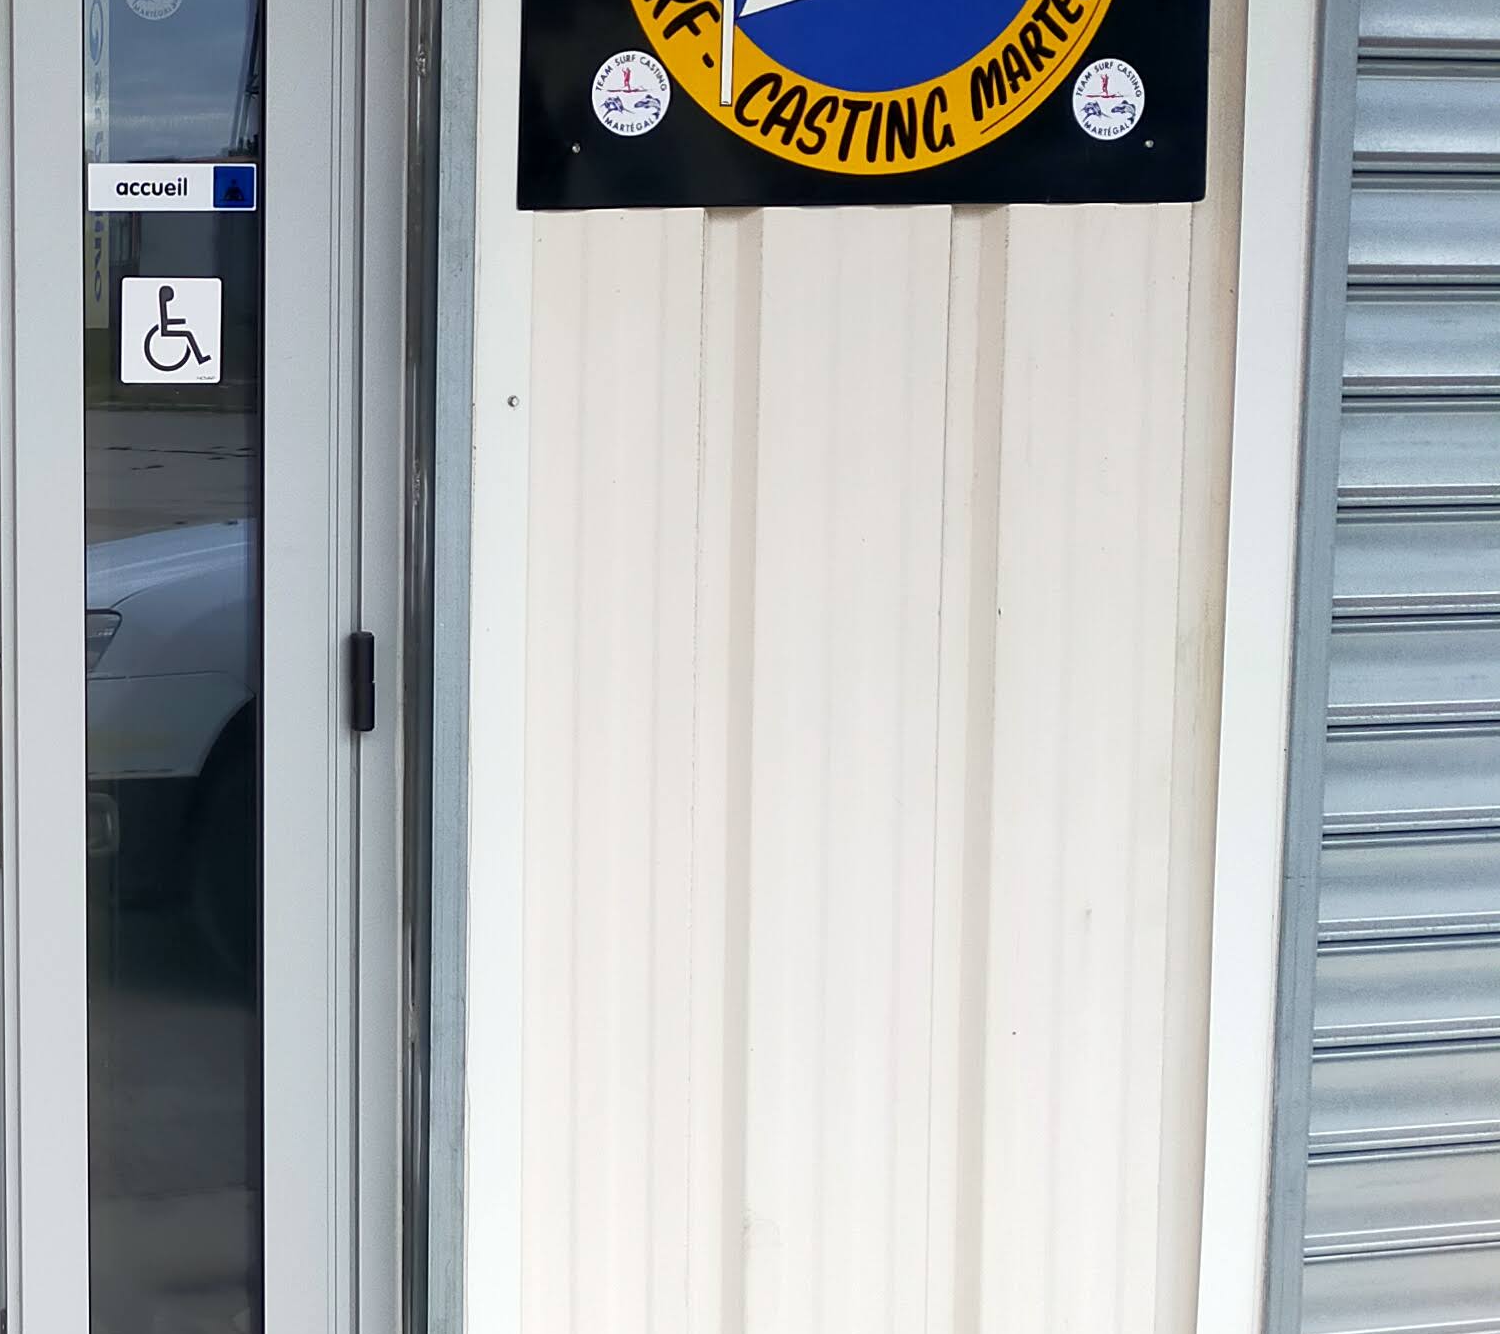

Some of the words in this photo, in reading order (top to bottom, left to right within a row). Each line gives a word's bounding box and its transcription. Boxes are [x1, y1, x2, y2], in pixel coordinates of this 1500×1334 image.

[595, 65, 614, 91] TEAM
[615, 54, 636, 67] SURF
[639, 56, 668, 92] CASTING
[1076, 71, 1093, 97] TEAM
[1094, 61, 1114, 73] SURF
[1117, 63, 1142, 98] CASTING
[734, 72, 956, 163] CASTING
[116, 177, 188, 196] accueil
